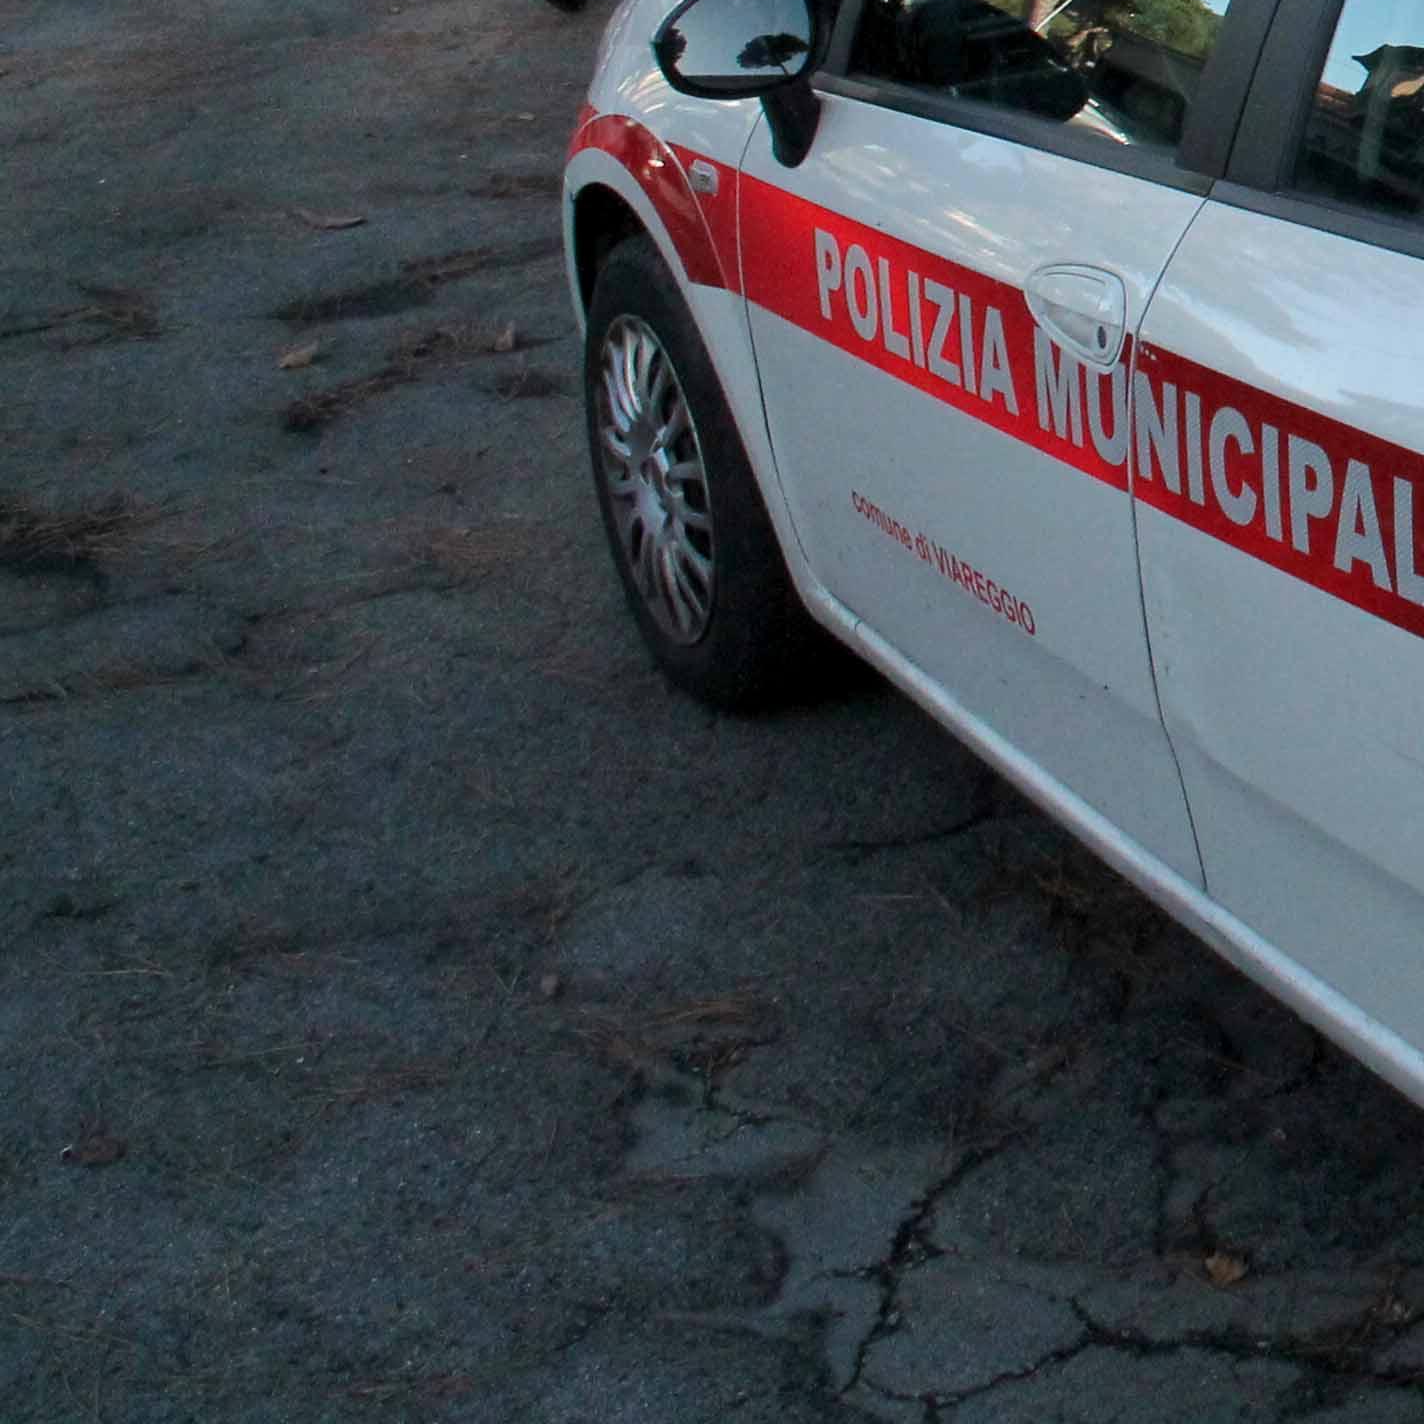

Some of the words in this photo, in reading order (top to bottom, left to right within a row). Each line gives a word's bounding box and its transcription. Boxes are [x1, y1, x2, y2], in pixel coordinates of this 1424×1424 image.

[814, 227, 1019, 417] POLIZIA
[852, 489, 912, 550] comune
[915, 532, 932, 566] di
[931, 539, 1036, 636] VIAREGGIO
